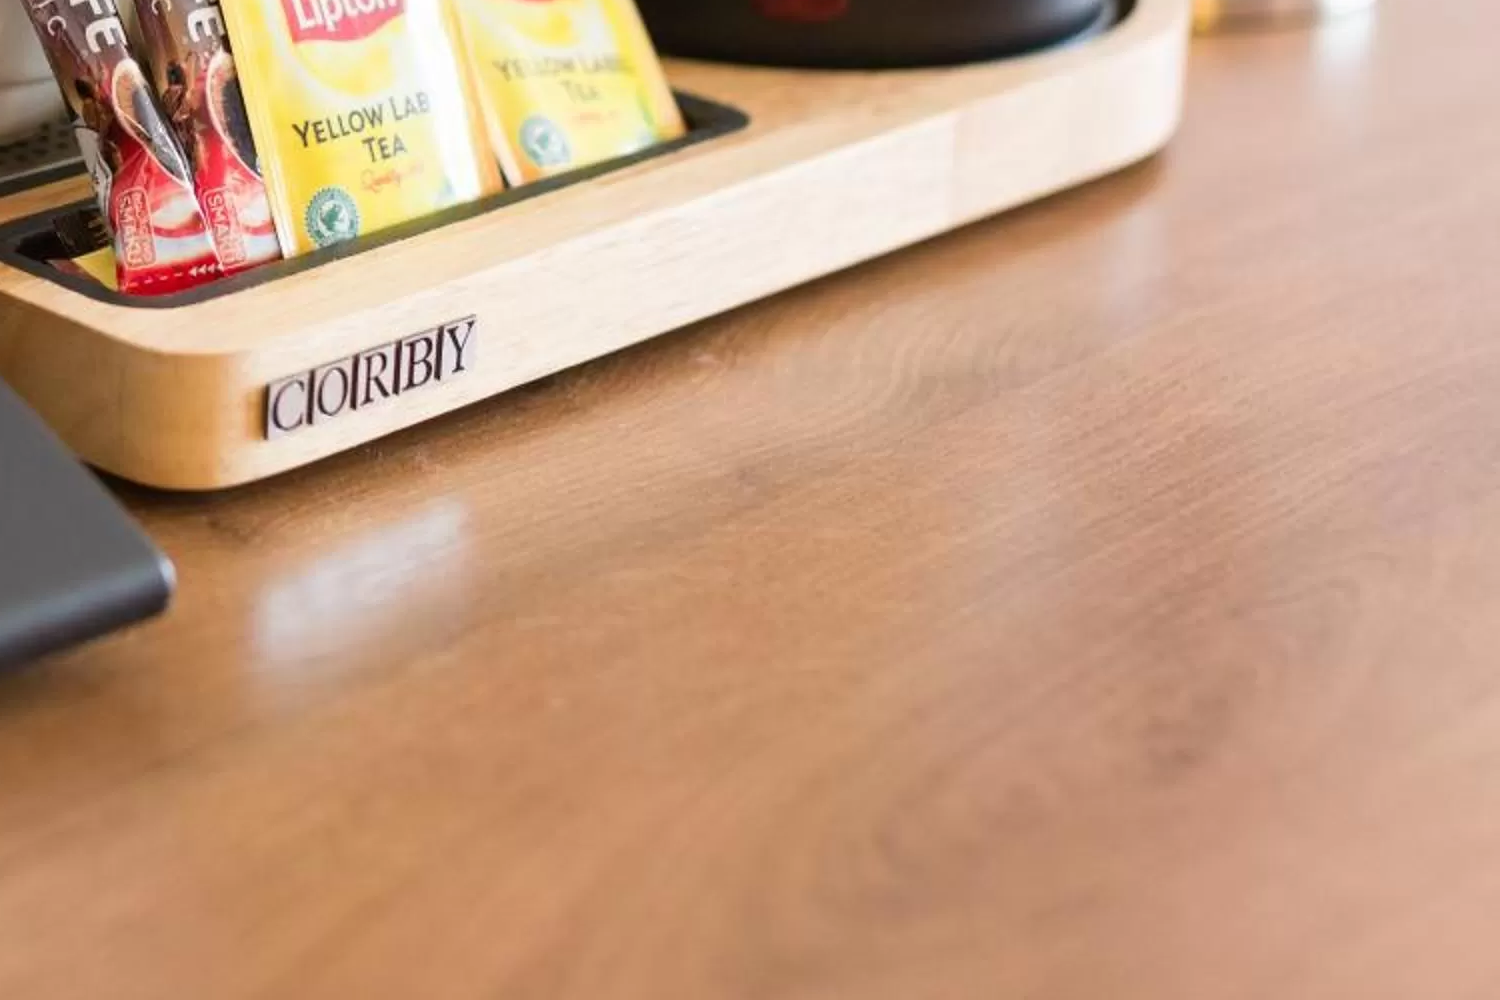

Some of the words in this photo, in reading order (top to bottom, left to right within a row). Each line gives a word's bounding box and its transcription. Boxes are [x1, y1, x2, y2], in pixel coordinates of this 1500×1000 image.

[291, 103, 384, 148] YELLOW
[388, 91, 431, 121] LAB
[361, 133, 408, 163] TEA
[268, 318, 477, 433] CORBY
